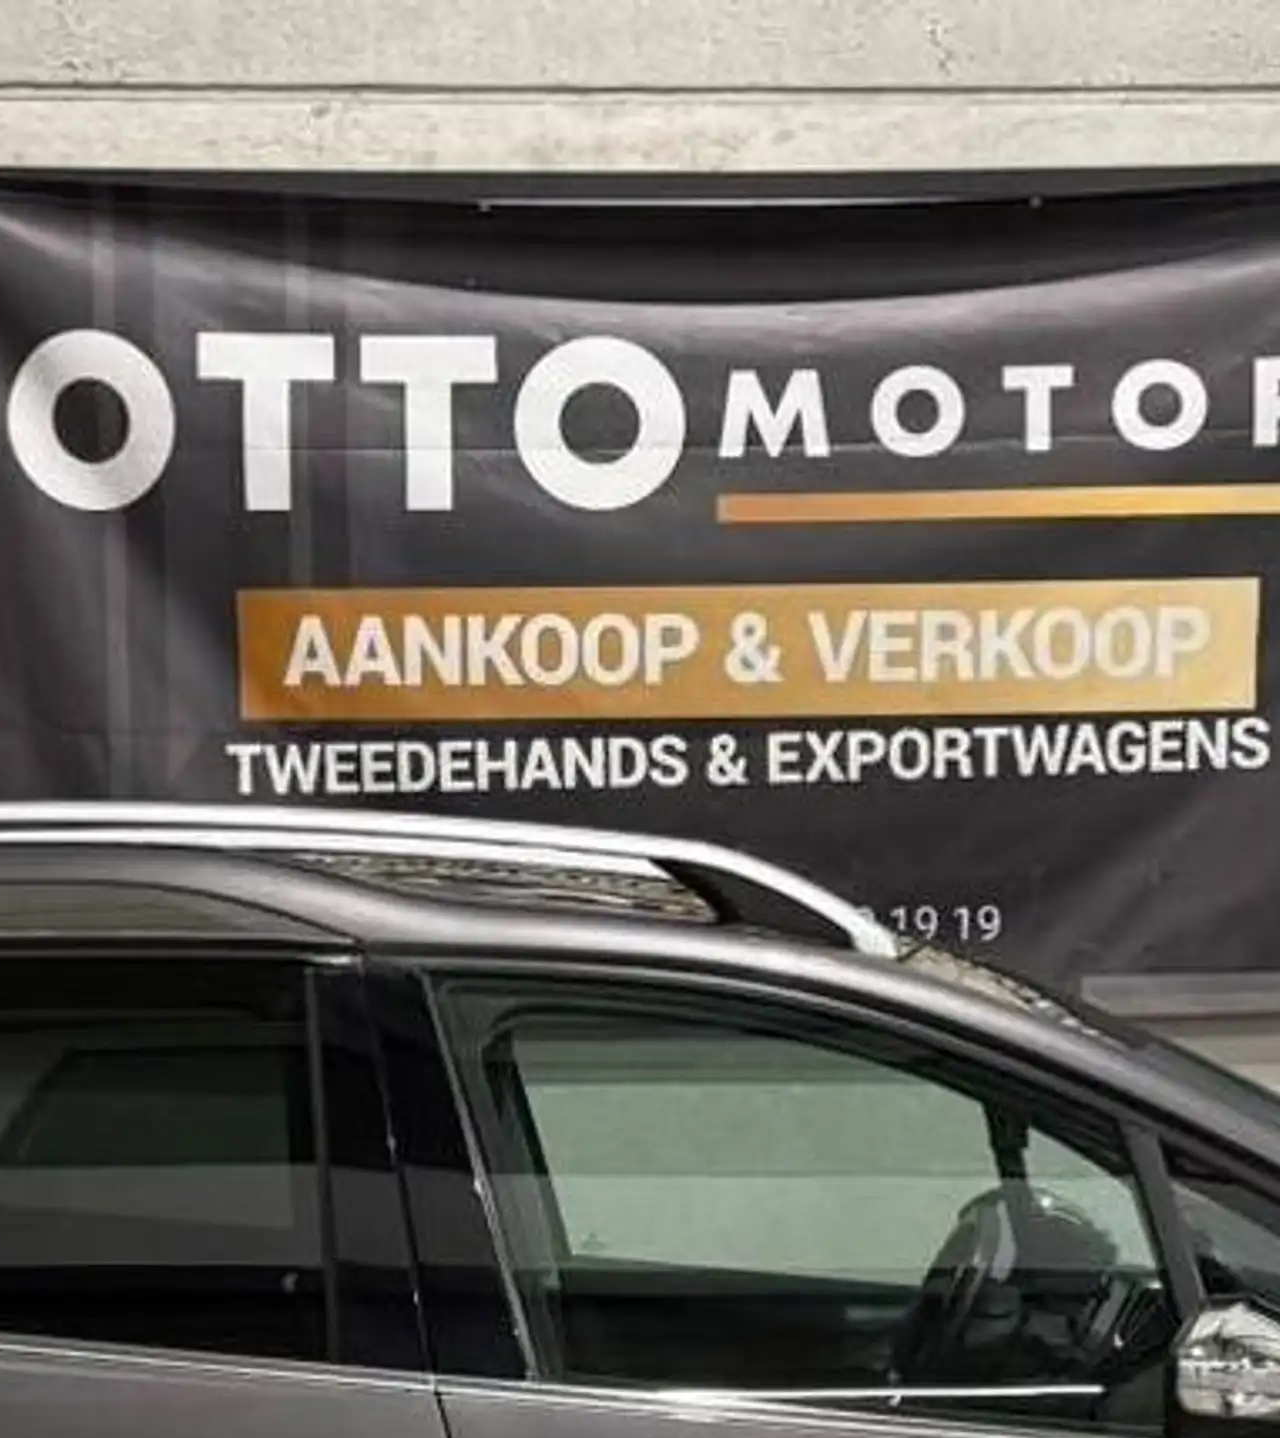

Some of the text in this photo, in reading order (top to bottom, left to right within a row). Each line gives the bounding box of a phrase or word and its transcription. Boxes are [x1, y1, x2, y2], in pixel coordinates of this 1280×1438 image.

[7, 329, 686, 511] OTTO
[283, 605, 1211, 688] AANKOOP & VERKOOP
[225, 718, 1272, 796] TWEEDEHANDS & EXPORTWAGENS
[953, 904, 1002, 942] 19
